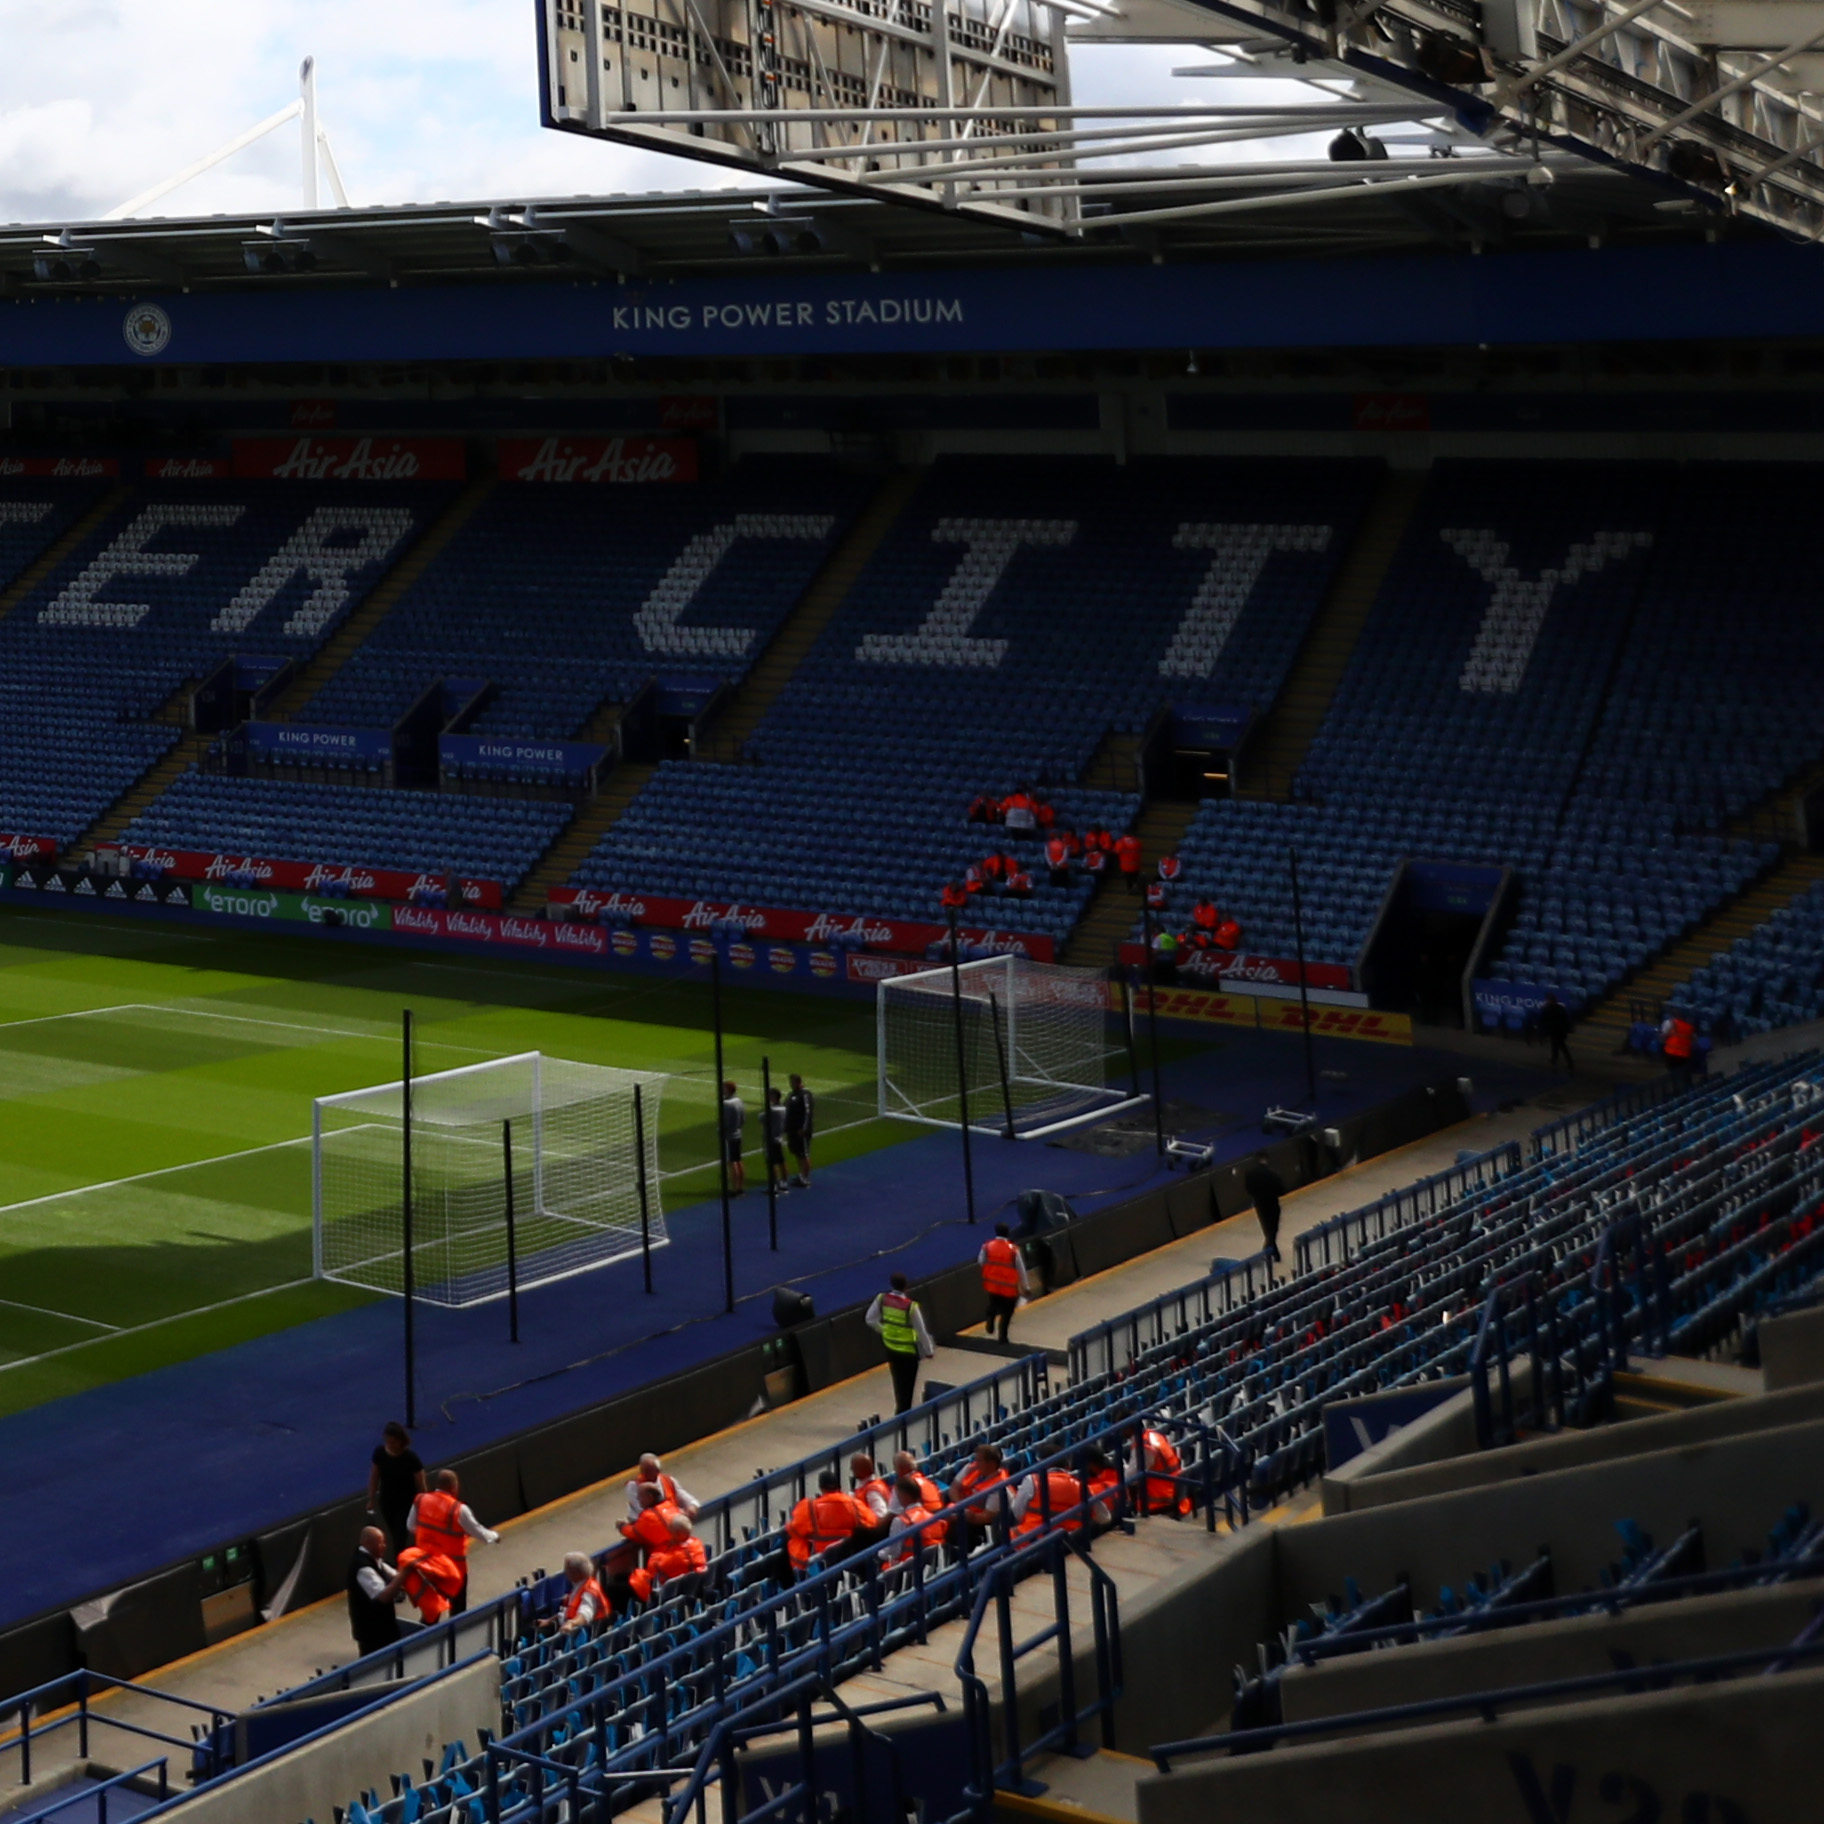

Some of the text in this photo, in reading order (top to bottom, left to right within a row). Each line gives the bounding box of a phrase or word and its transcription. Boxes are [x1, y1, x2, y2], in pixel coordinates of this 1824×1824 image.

[612, 299, 963, 330] KING POWER STADIUM
[632, 514, 1656, 693] CITY
[278, 731, 356, 747] KING POWER
[478, 744, 563, 761] KING POWER
[393, 907, 440, 935] Vitality
[446, 912, 493, 941] Vitality
[499, 917, 547, 947] Vitality
[554, 923, 603, 953] Vitality
[1133, 989, 1235, 1019] DHL
[1278, 1006, 1390, 1037] DHL
